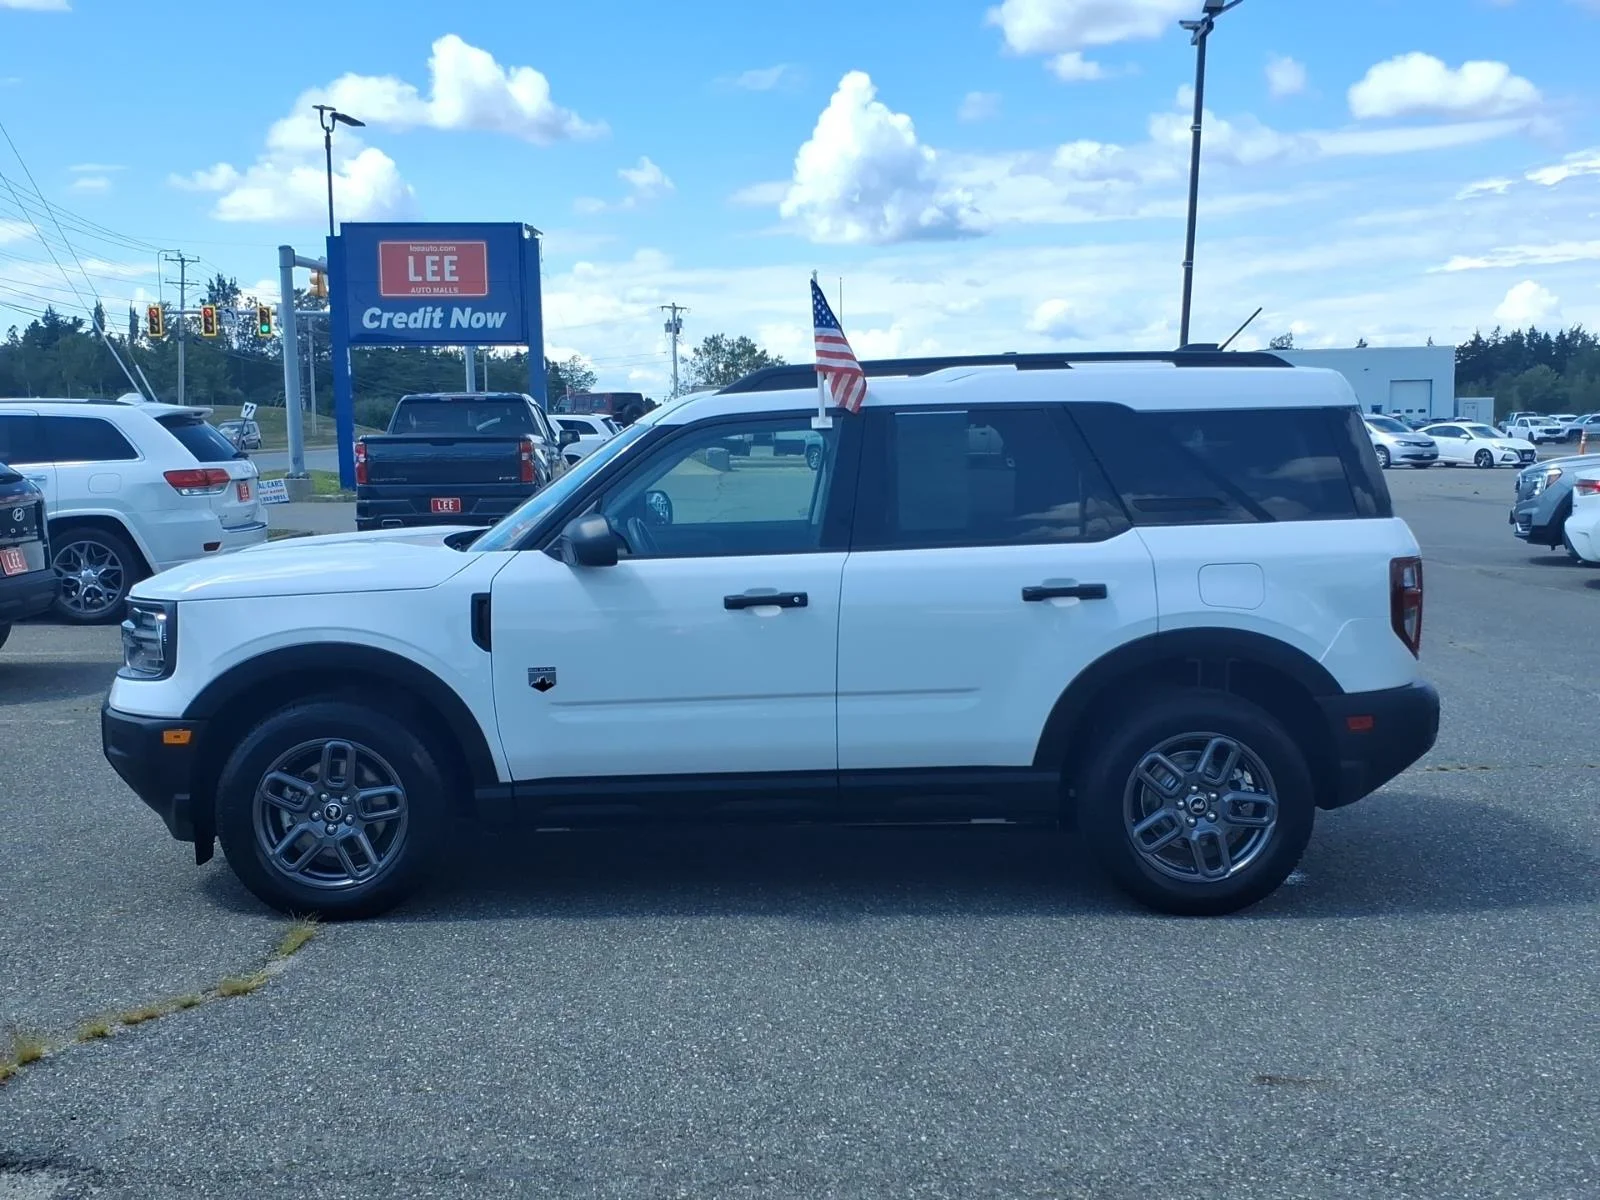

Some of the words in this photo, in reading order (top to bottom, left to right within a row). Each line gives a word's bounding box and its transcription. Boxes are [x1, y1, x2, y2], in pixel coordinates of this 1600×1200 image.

[408, 255, 459, 282] LEE
[362, 306, 444, 329] Credit
[450, 306, 507, 329] Now
[437, 501, 454, 510] LEE
[5, 552, 23, 569] LEE
